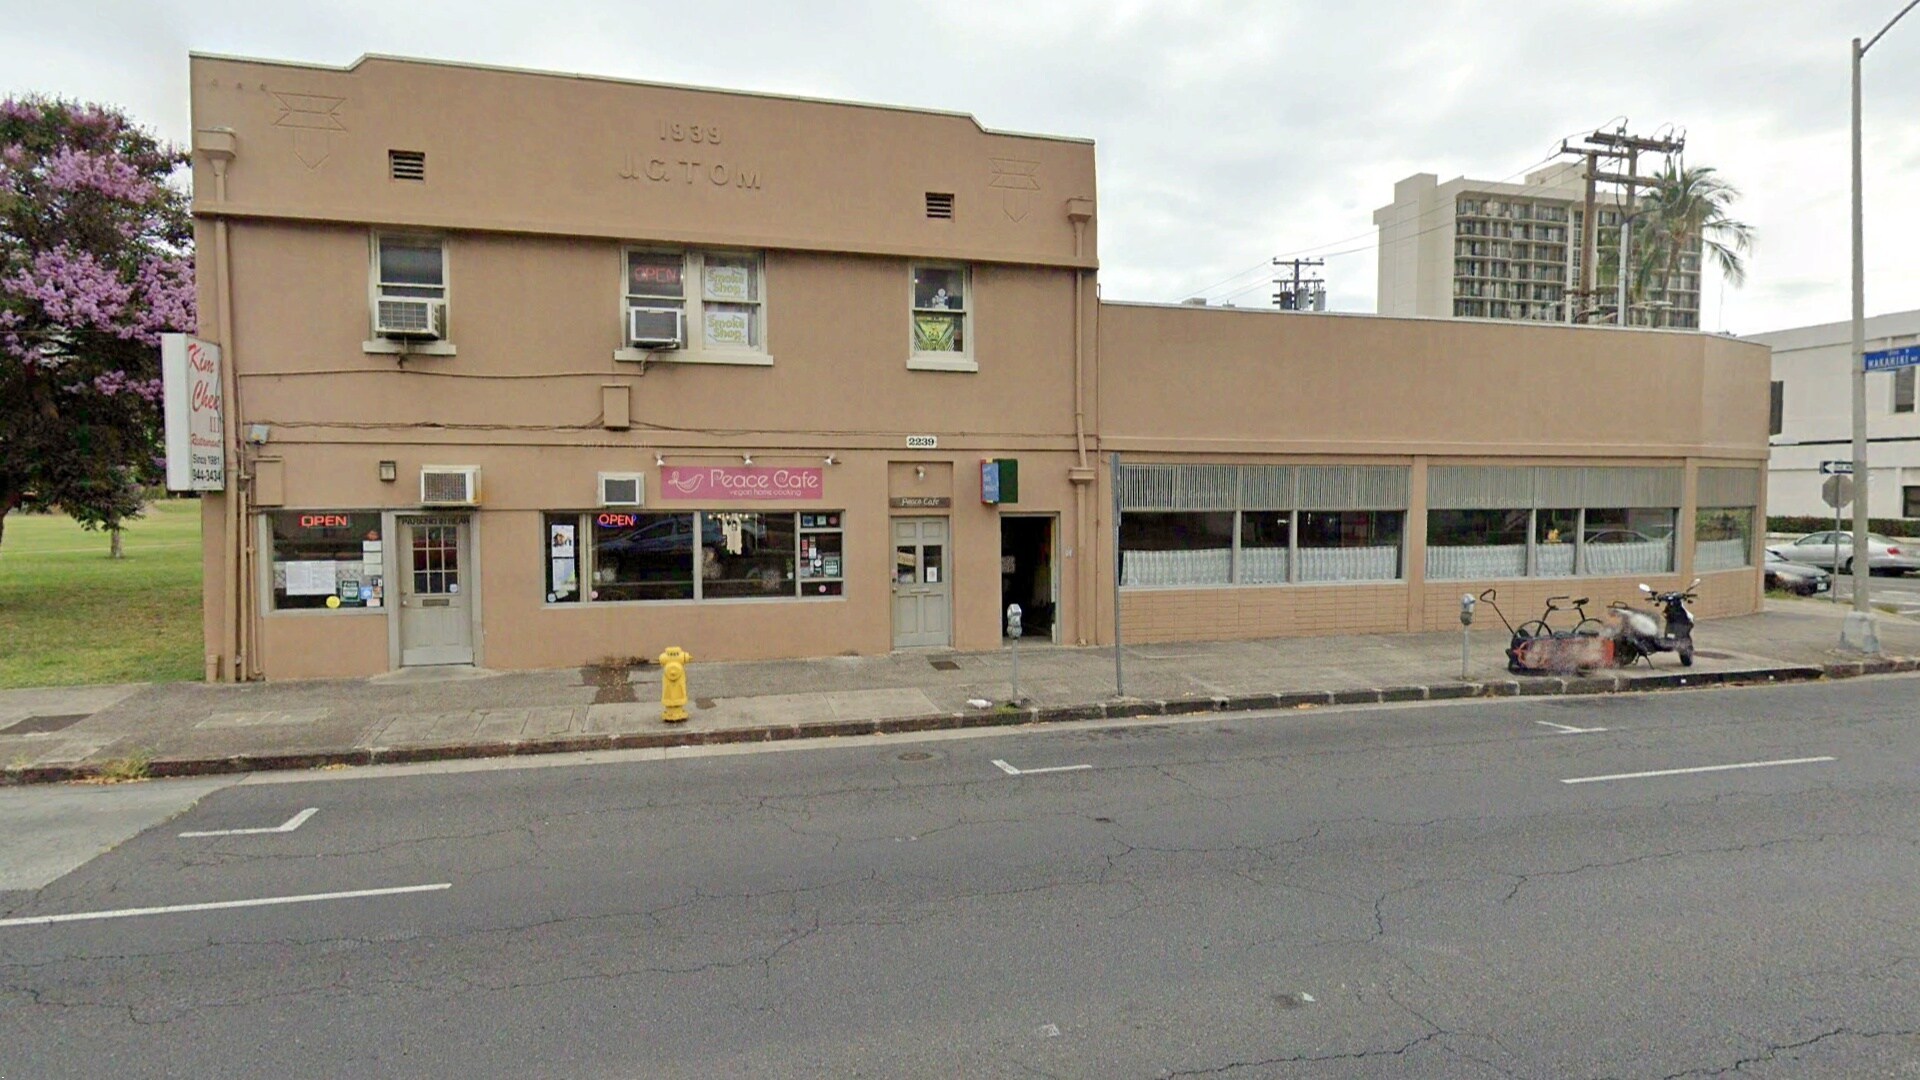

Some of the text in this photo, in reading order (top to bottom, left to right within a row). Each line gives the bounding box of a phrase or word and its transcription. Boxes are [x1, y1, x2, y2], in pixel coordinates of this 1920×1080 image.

[659, 120, 721, 145] 1939
[678, 161, 761, 190] TOM
[634, 267, 677, 284] OPEN
[708, 315, 744, 329] Smoke
[714, 327, 742, 341] Shop
[188, 343, 214, 373] Kim
[192, 380, 219, 412] Chee
[909, 438, 934, 446] 2239
[710, 469, 819, 489] Peace Cafe
[773, 488, 802, 496] cooking
[301, 515, 347, 527] OPEN
[599, 513, 635, 526] OPEN
